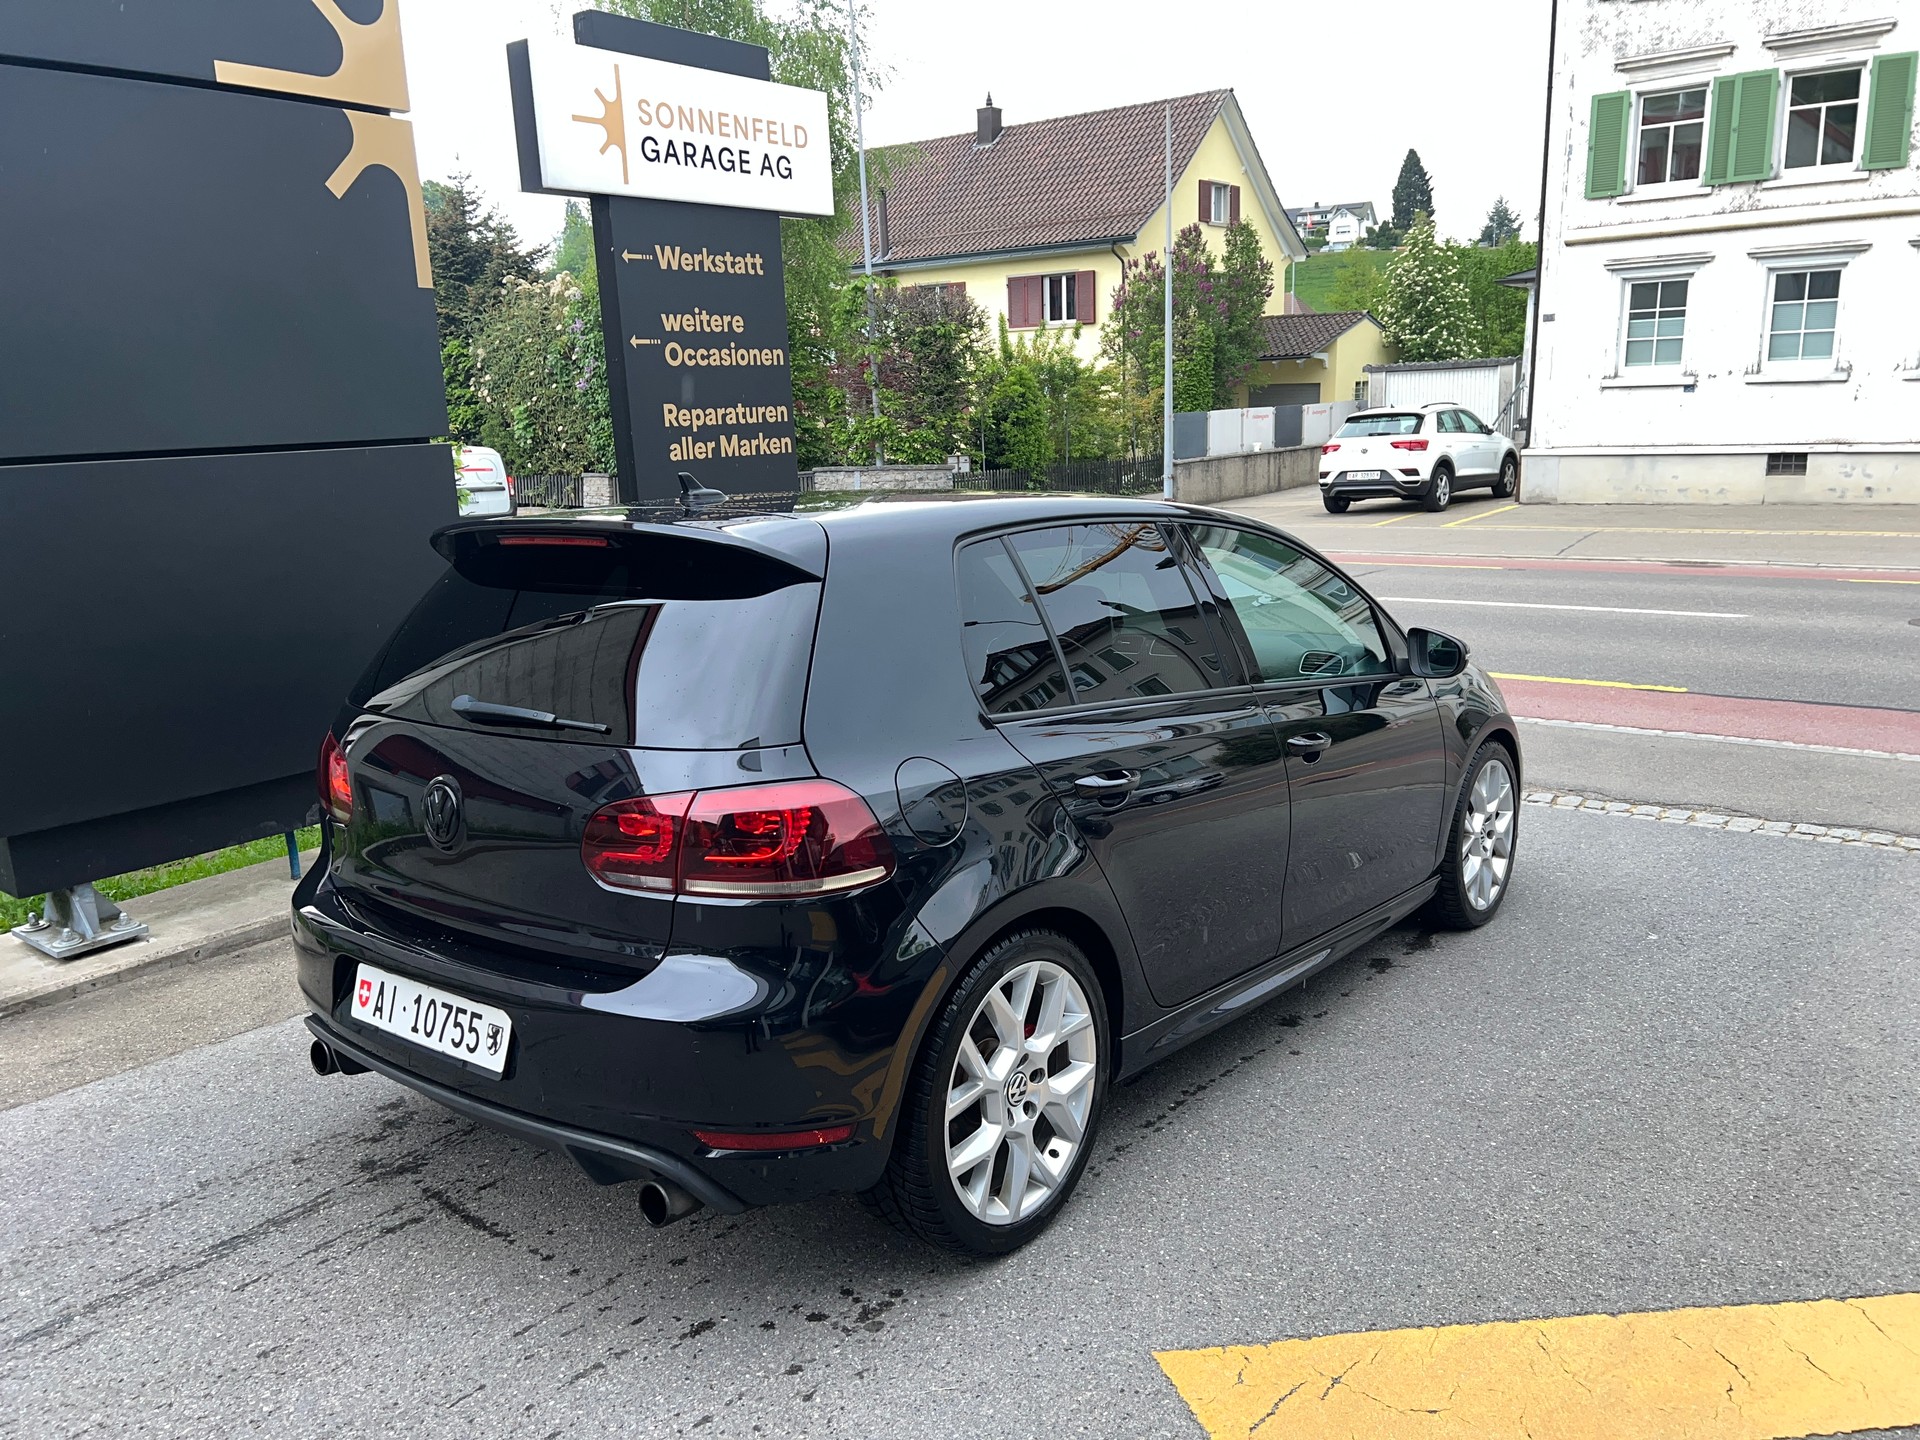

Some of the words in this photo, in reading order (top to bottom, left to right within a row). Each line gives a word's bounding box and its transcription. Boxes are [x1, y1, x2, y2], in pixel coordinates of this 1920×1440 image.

[637, 98, 808, 149] SONNENFELD
[641, 136, 751, 175] GARAGE
[760, 153, 793, 180] AG
[654, 244, 764, 276] Werkstatt
[660, 307, 744, 333] weitere
[664, 341, 784, 367] Occasionen
[662, 402, 788, 432] Reparaturen
[669, 435, 716, 462] aller
[719, 432, 793, 458] Marken
